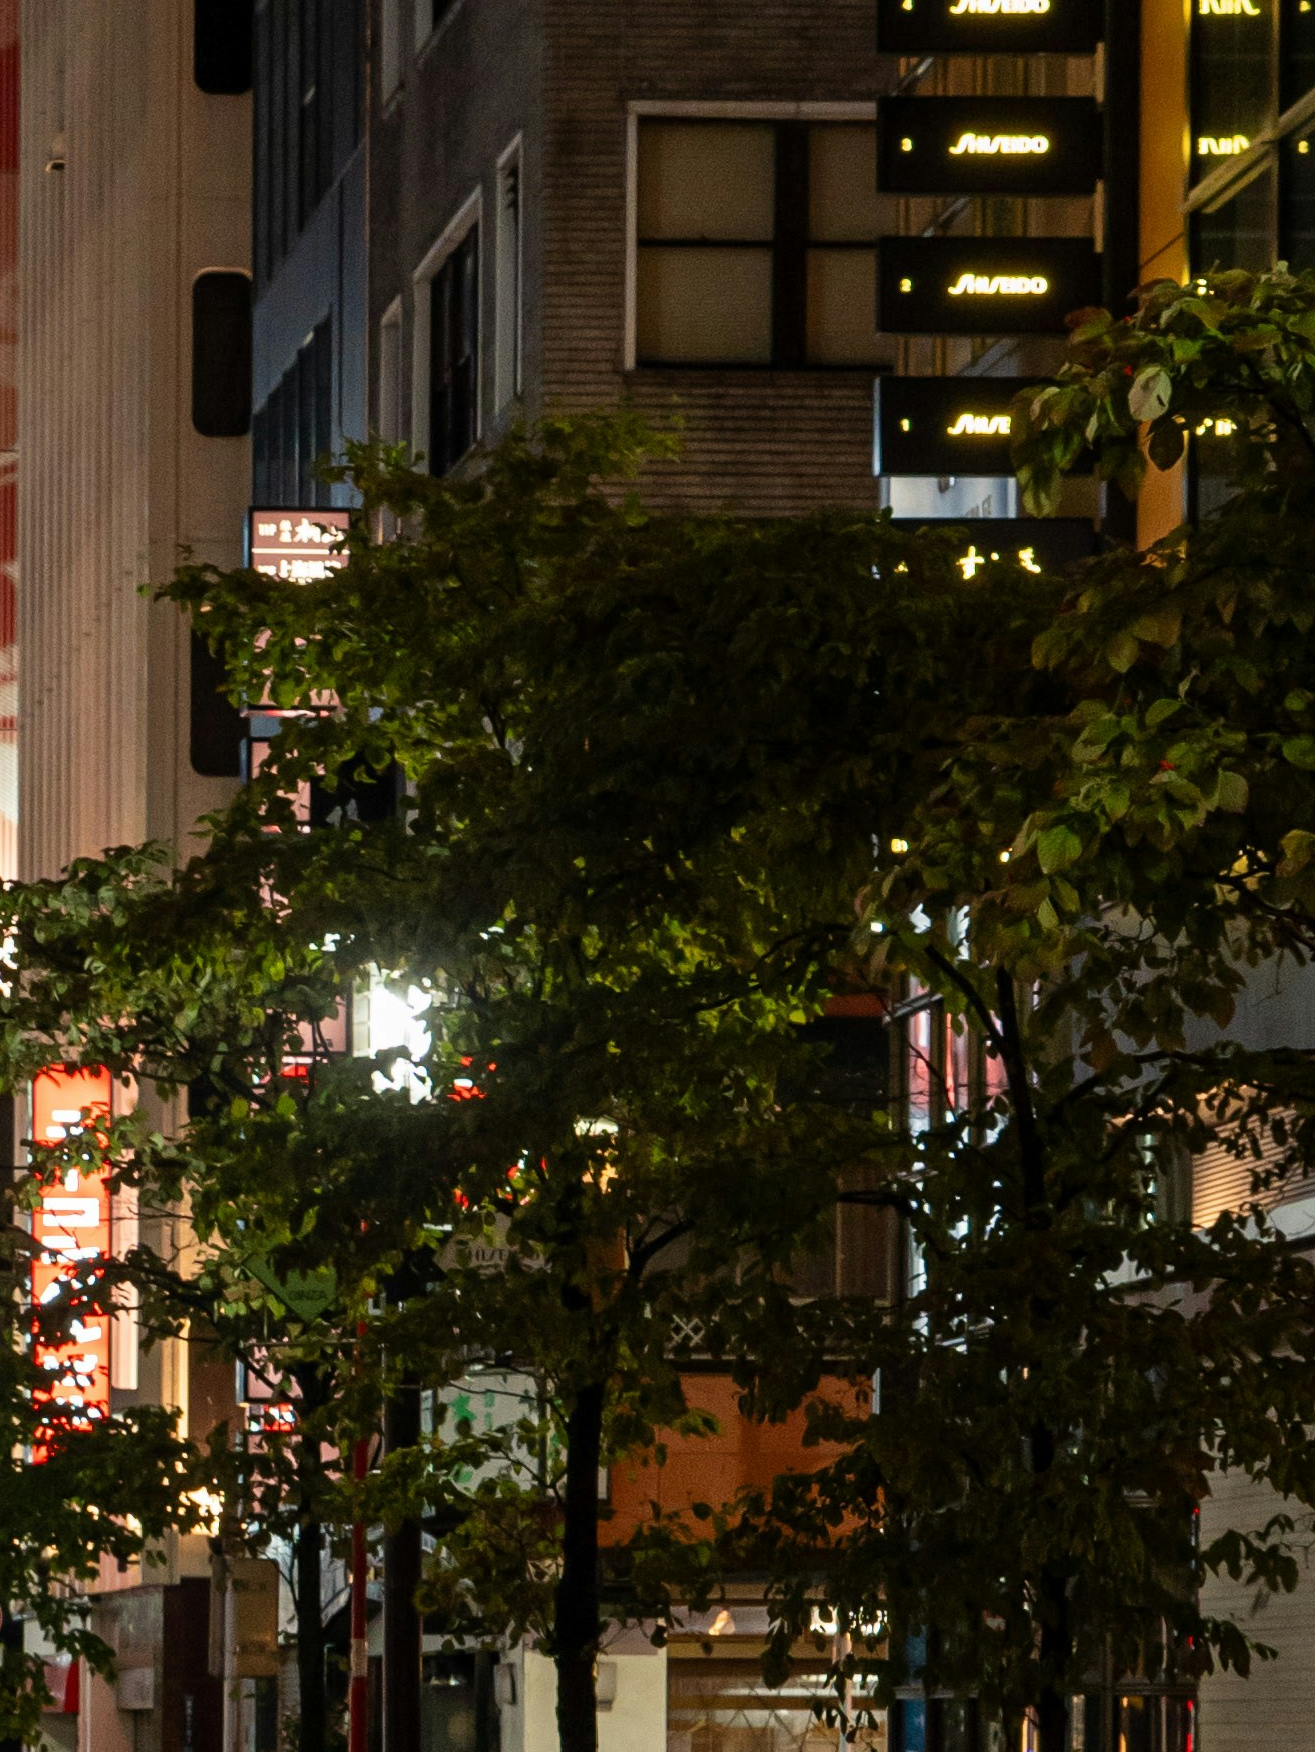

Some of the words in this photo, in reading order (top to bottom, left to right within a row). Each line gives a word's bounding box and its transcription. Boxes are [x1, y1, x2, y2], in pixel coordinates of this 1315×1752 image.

[949, 130, 1051, 155] SHISEIDO
[948, 271, 1049, 296] SHISEIDO
[947, 411, 1013, 436] SHISE
